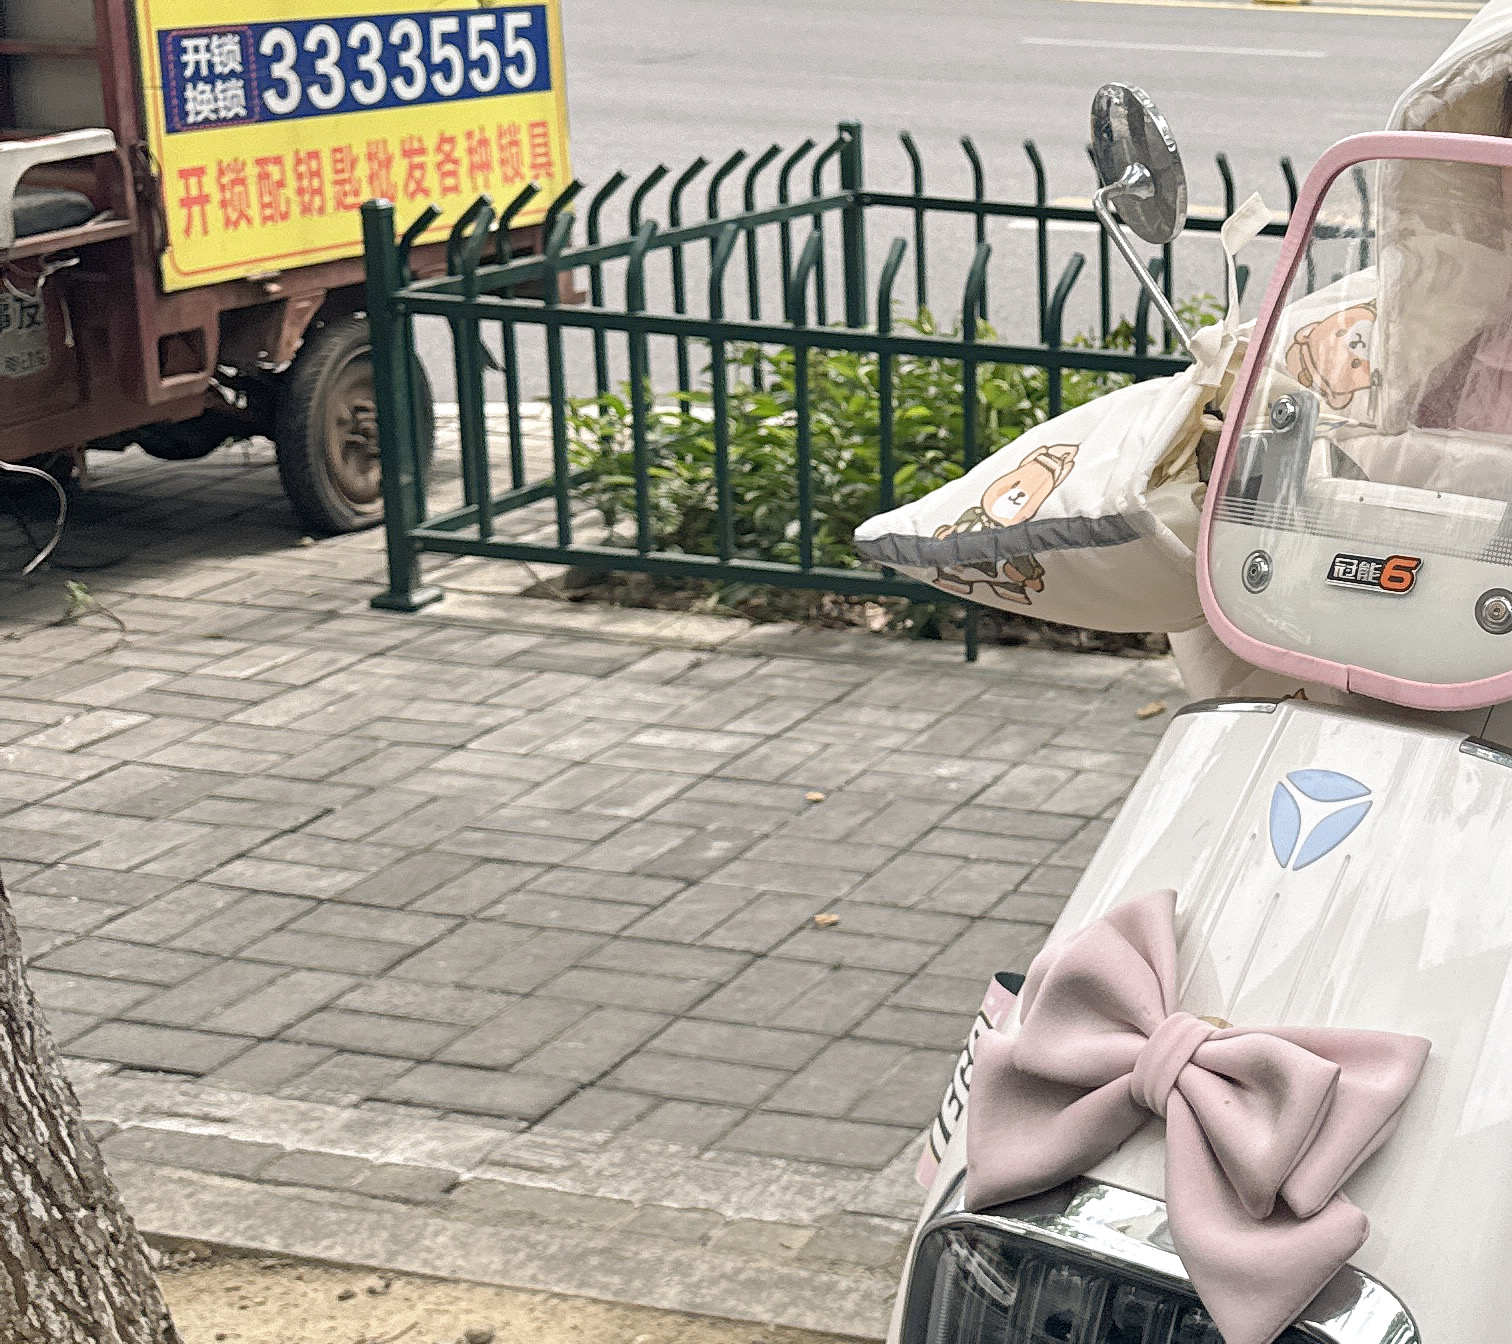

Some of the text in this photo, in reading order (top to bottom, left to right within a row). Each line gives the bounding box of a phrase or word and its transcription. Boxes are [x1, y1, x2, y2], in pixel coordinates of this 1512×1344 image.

[179, 33, 244, 78] 开锁
[259, 11, 538, 116] 3333555
[183, 77, 248, 125] 换锁
[177, 119, 556, 238] 开锁配钥匙批发各种锁具
